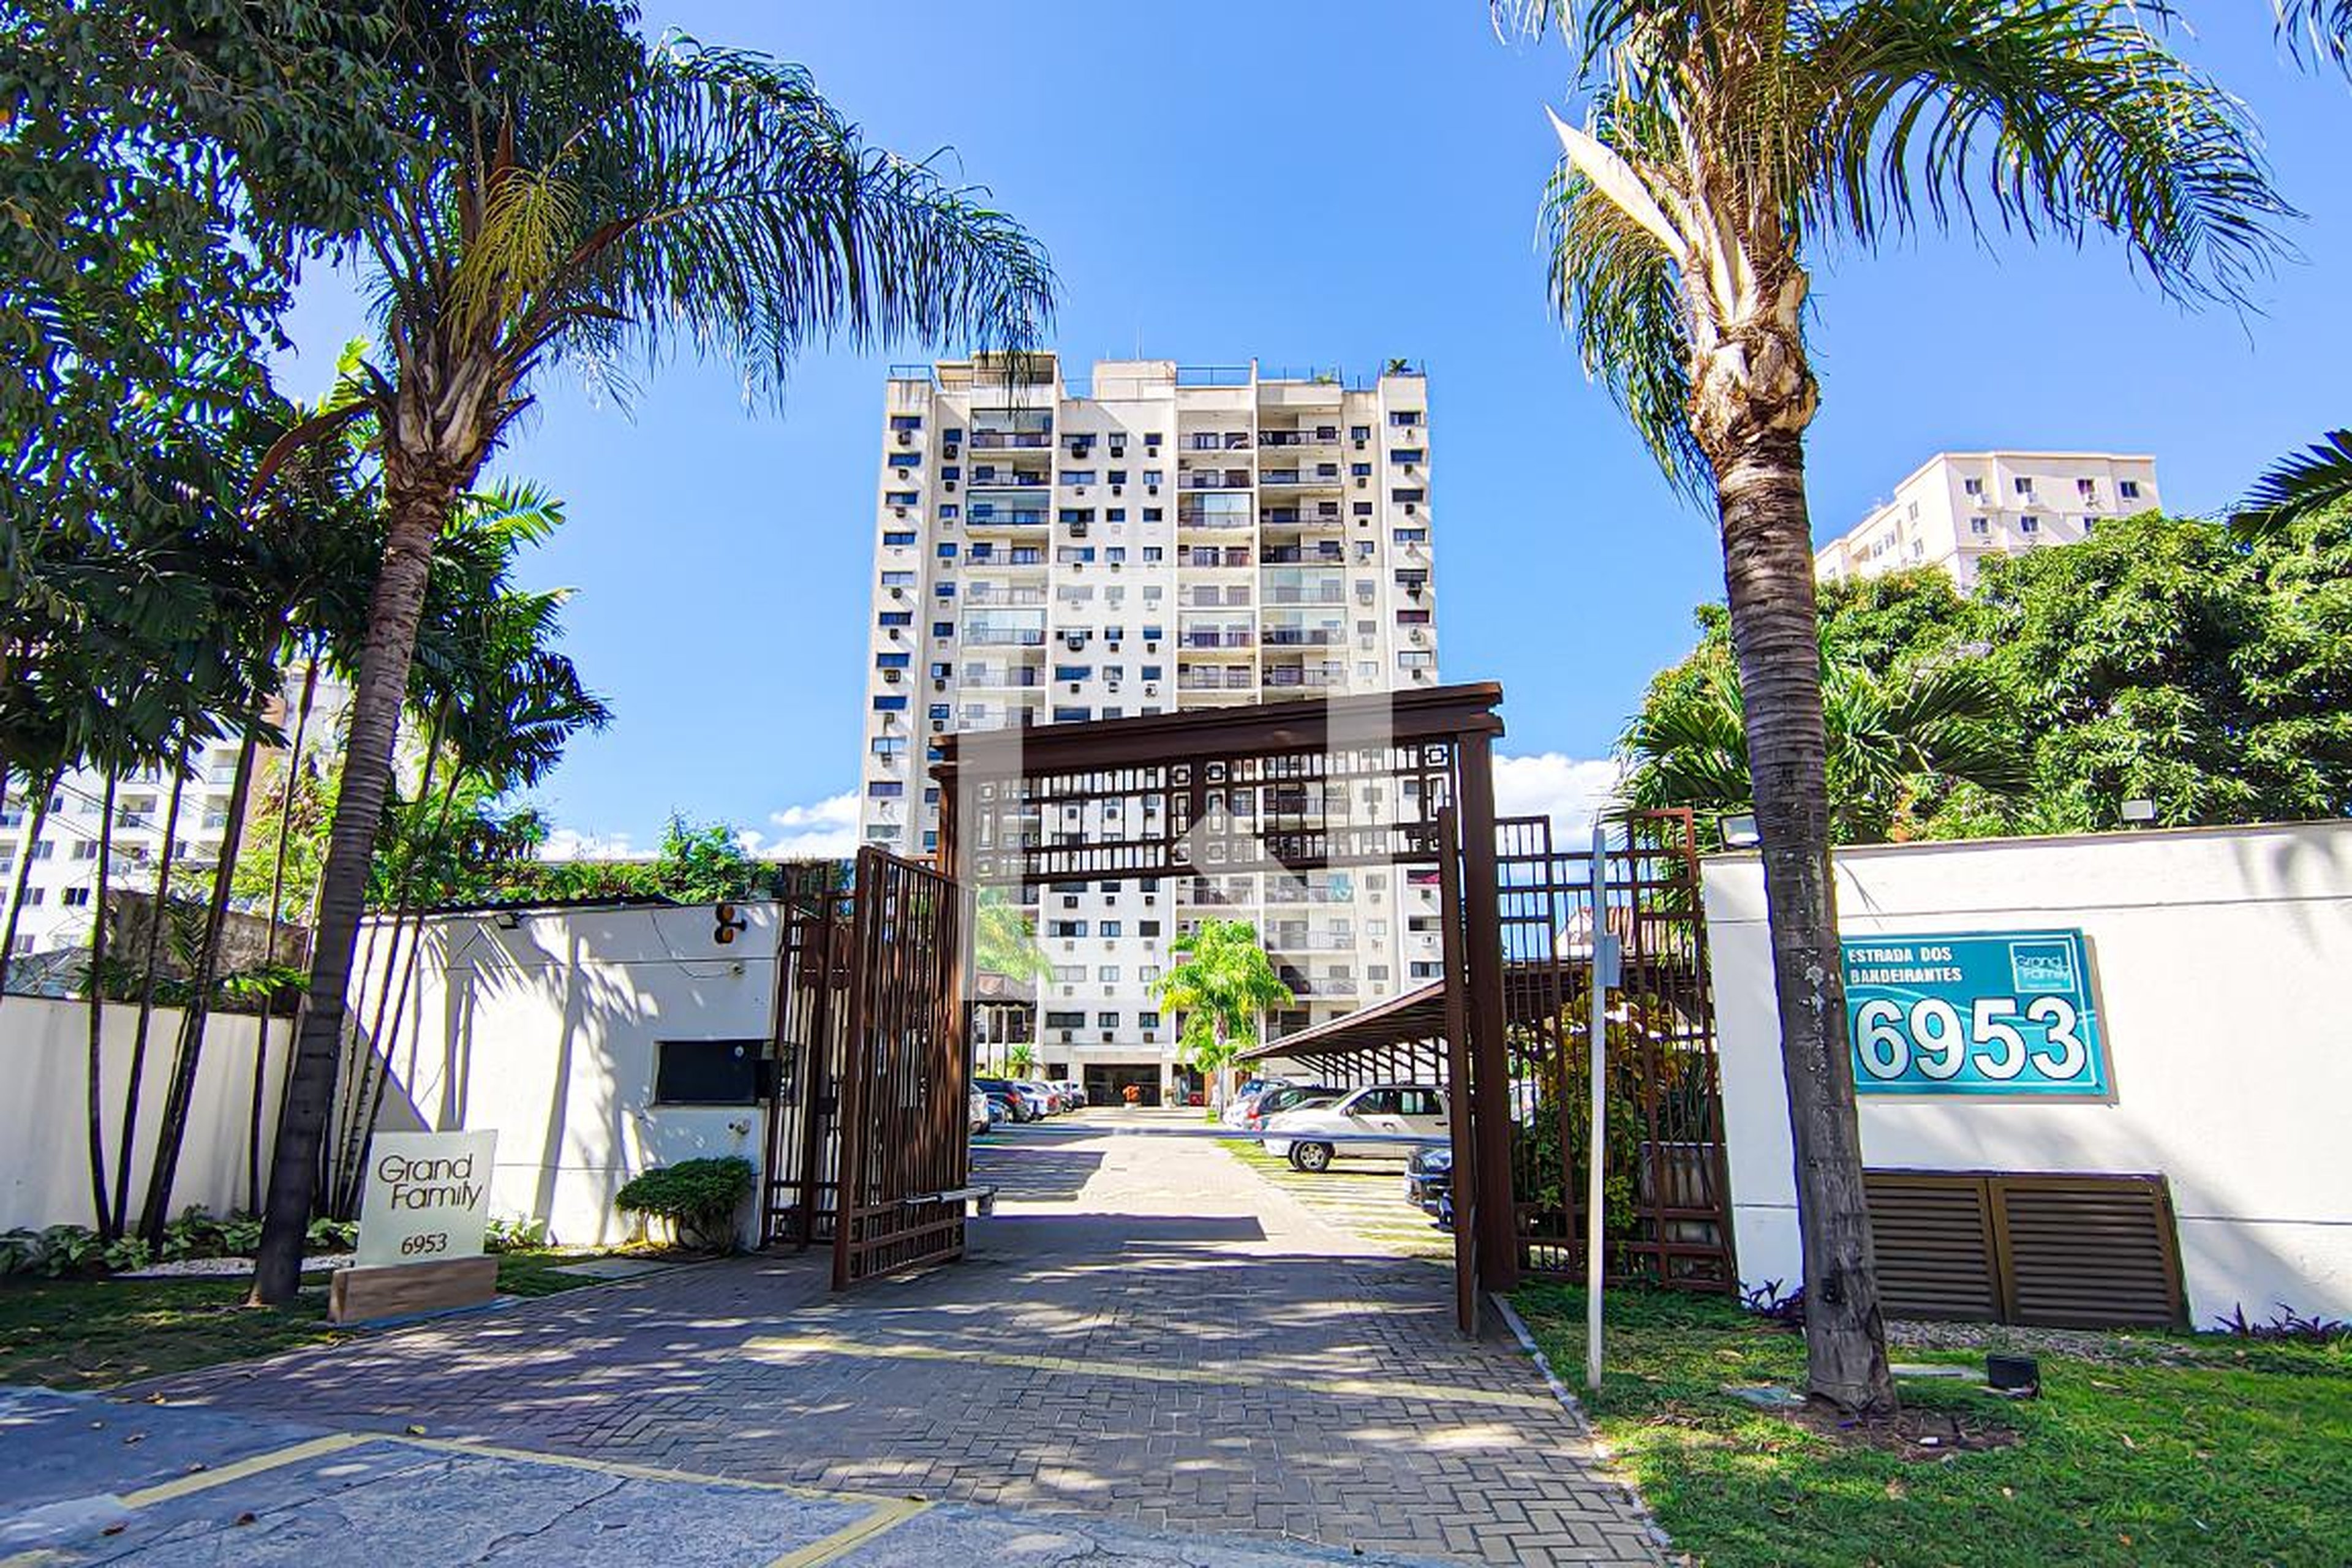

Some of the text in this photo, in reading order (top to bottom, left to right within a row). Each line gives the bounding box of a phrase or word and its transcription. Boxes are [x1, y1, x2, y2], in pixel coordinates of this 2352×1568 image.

[1848, 947, 1953, 963] ESTRADA DOS
[1850, 967, 1962, 983] BANDEIRANTES
[1855, 995, 2087, 1080] 6953
[379, 1153, 473, 1183] Grand
[391, 1180, 483, 1212] Family
[402, 1232, 448, 1254] 6953
